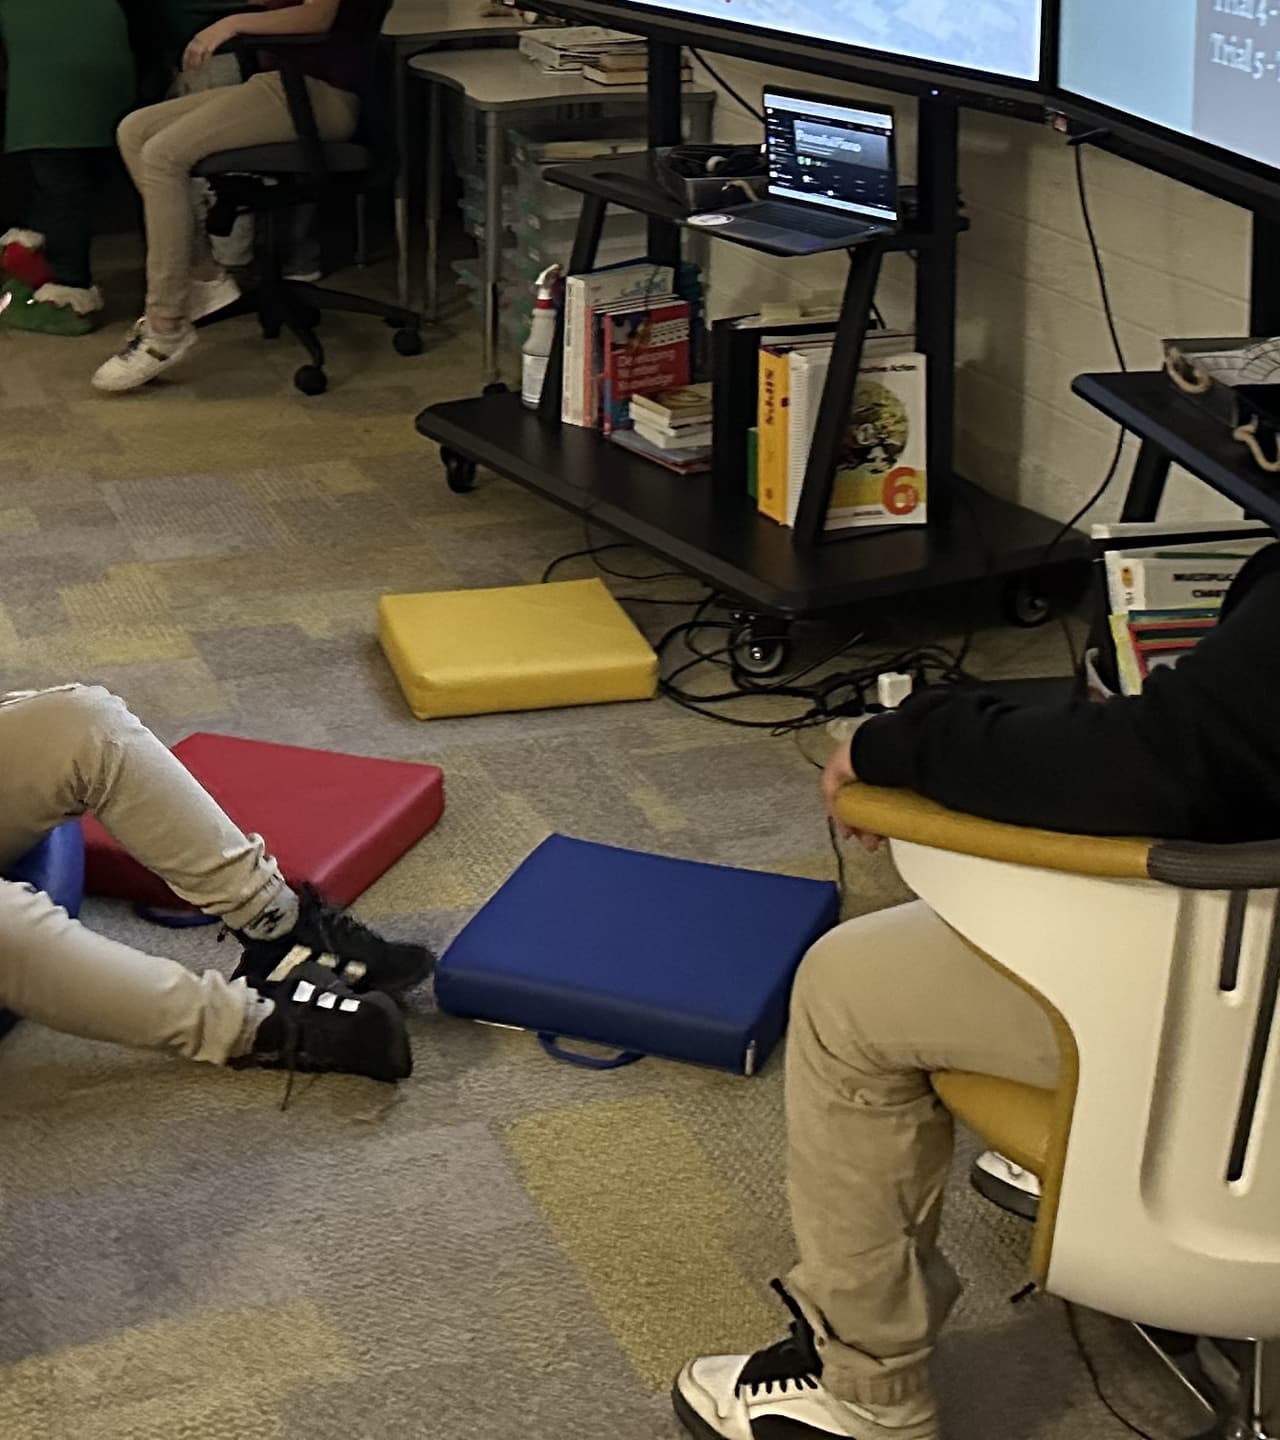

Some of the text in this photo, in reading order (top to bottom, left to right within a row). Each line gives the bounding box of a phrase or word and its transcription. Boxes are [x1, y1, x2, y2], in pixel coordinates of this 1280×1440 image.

[1209, 32, 1253, 73] Trial
[1253, 50, 1265, 80] 5
[882, 466, 919, 516] 6
